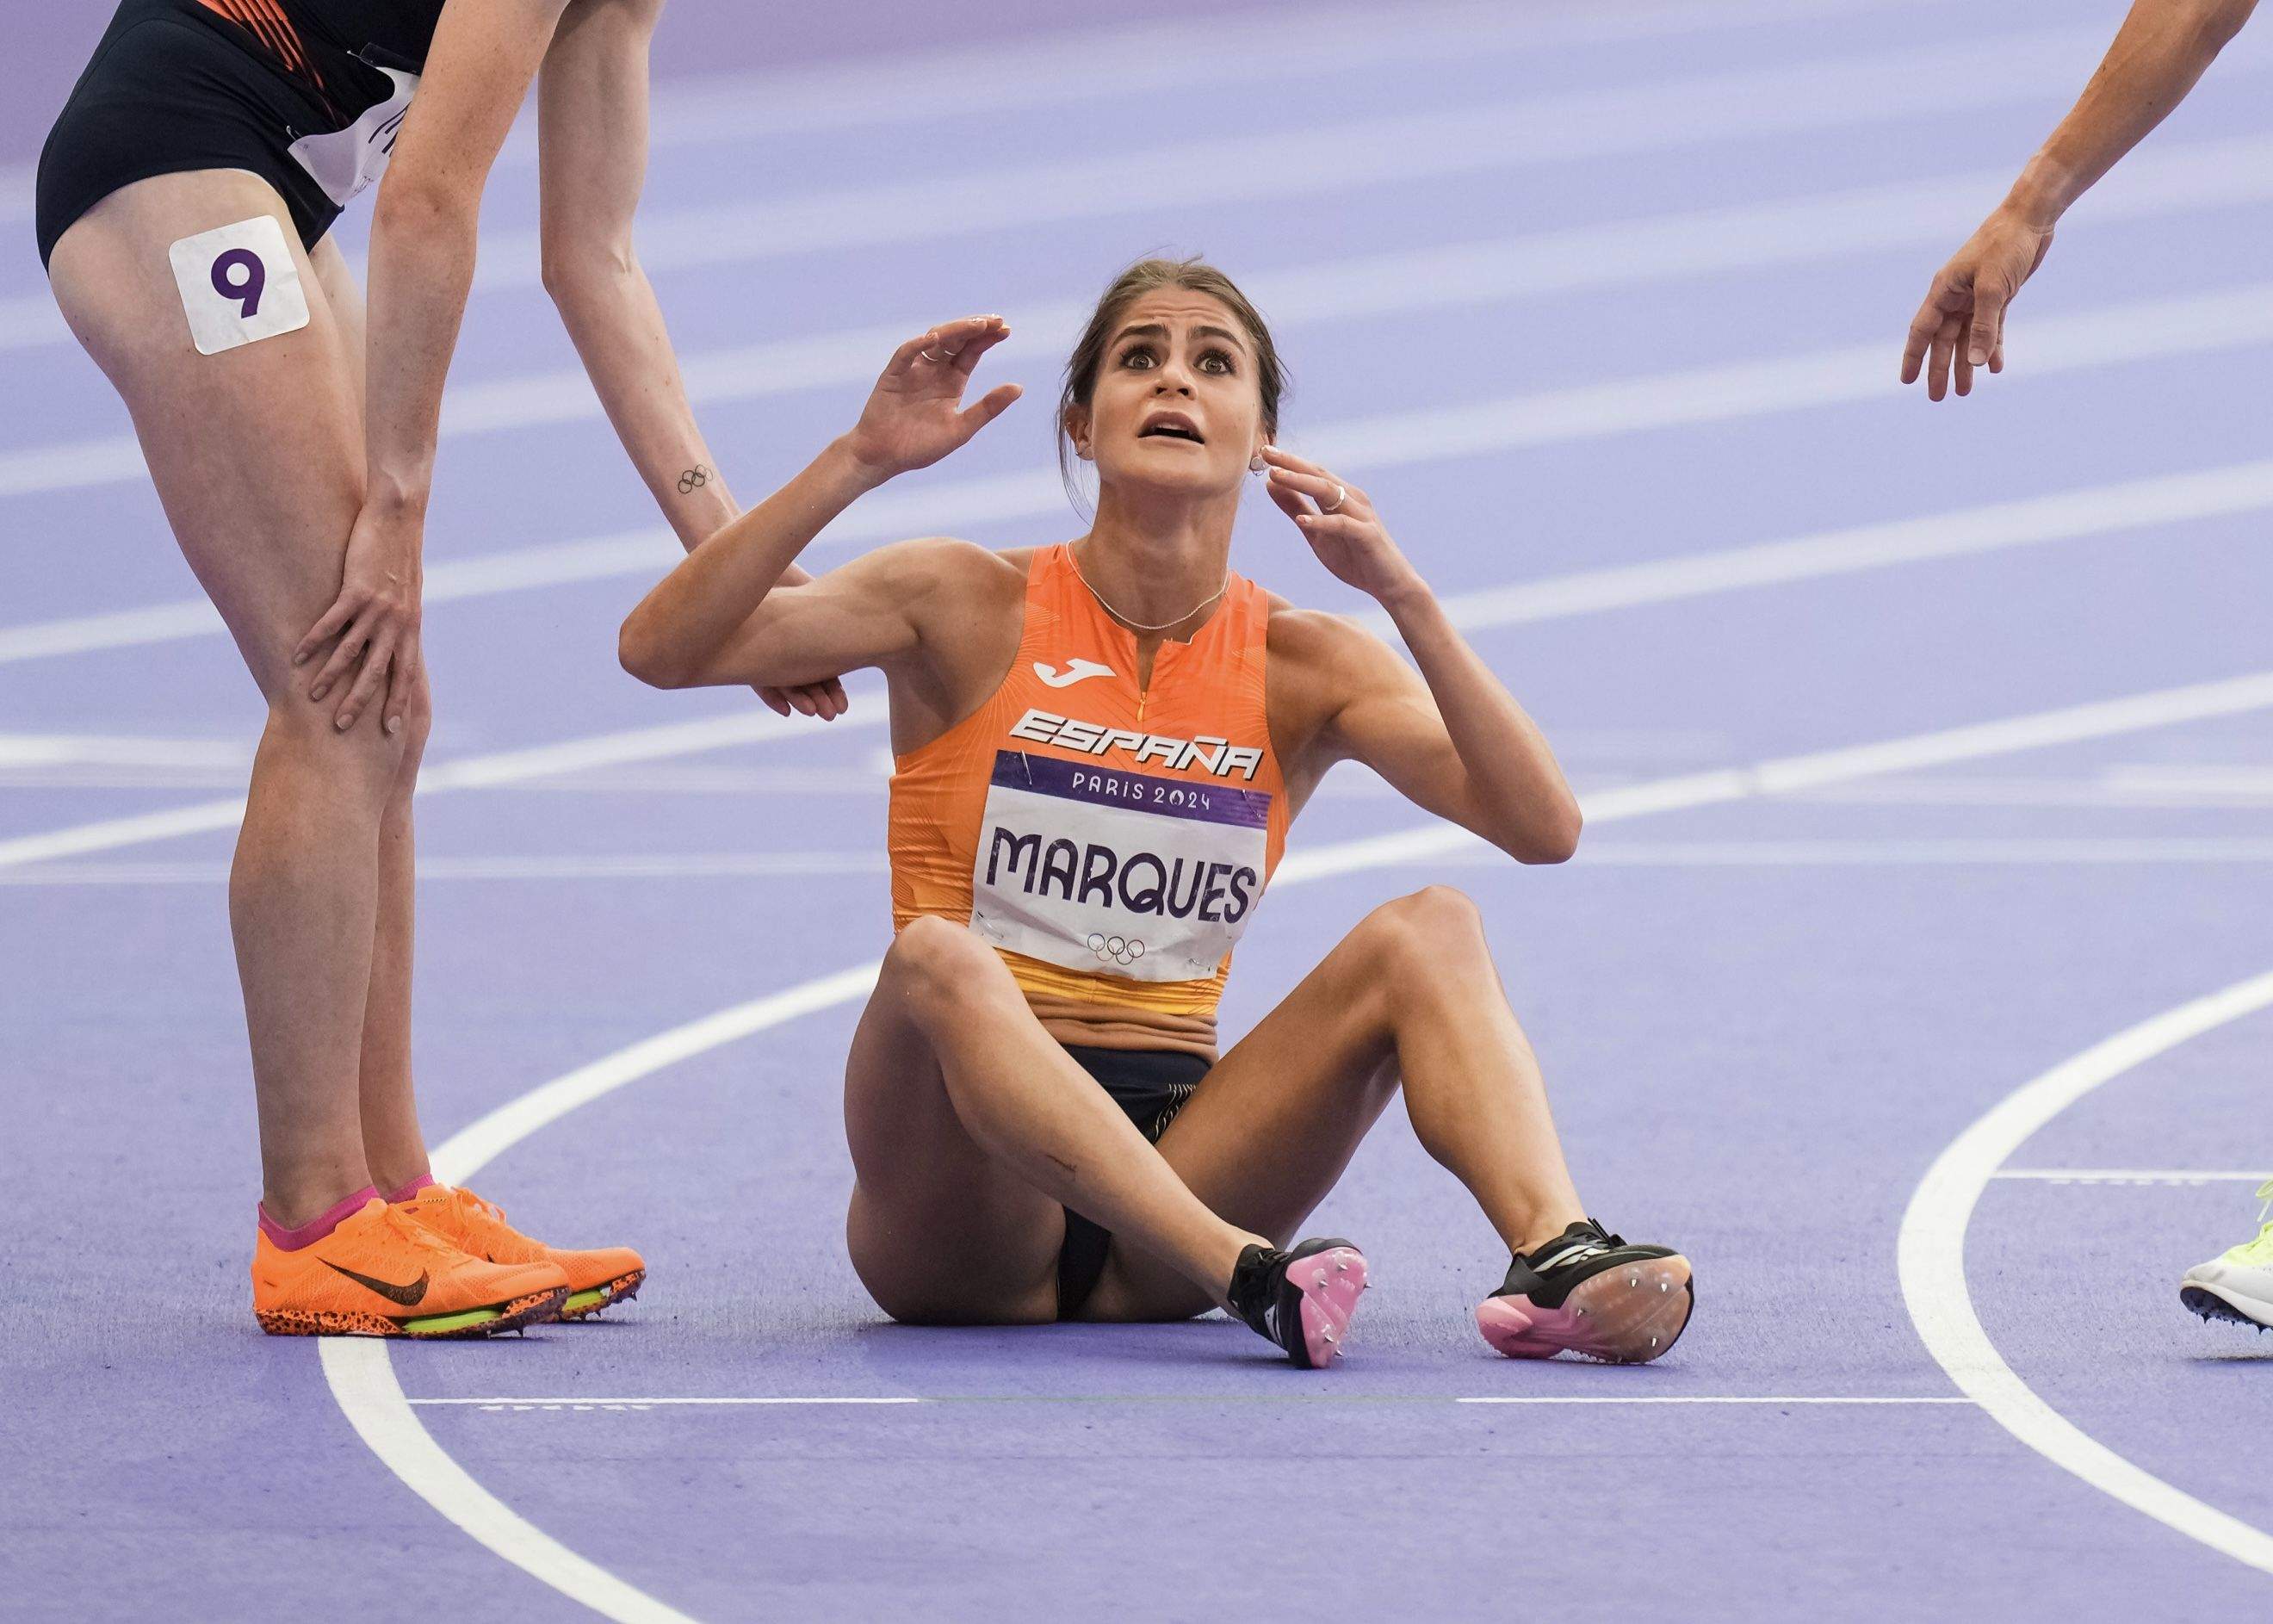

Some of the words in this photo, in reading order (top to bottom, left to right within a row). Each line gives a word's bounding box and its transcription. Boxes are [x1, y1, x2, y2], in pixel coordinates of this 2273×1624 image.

[212, 249, 264, 319] 9
[1010, 709, 1262, 779] ESPAÑA
[1073, 772, 1144, 800] PARIS
[1153, 788, 1210, 809] 2024
[987, 827, 1256, 923] MARQUES
